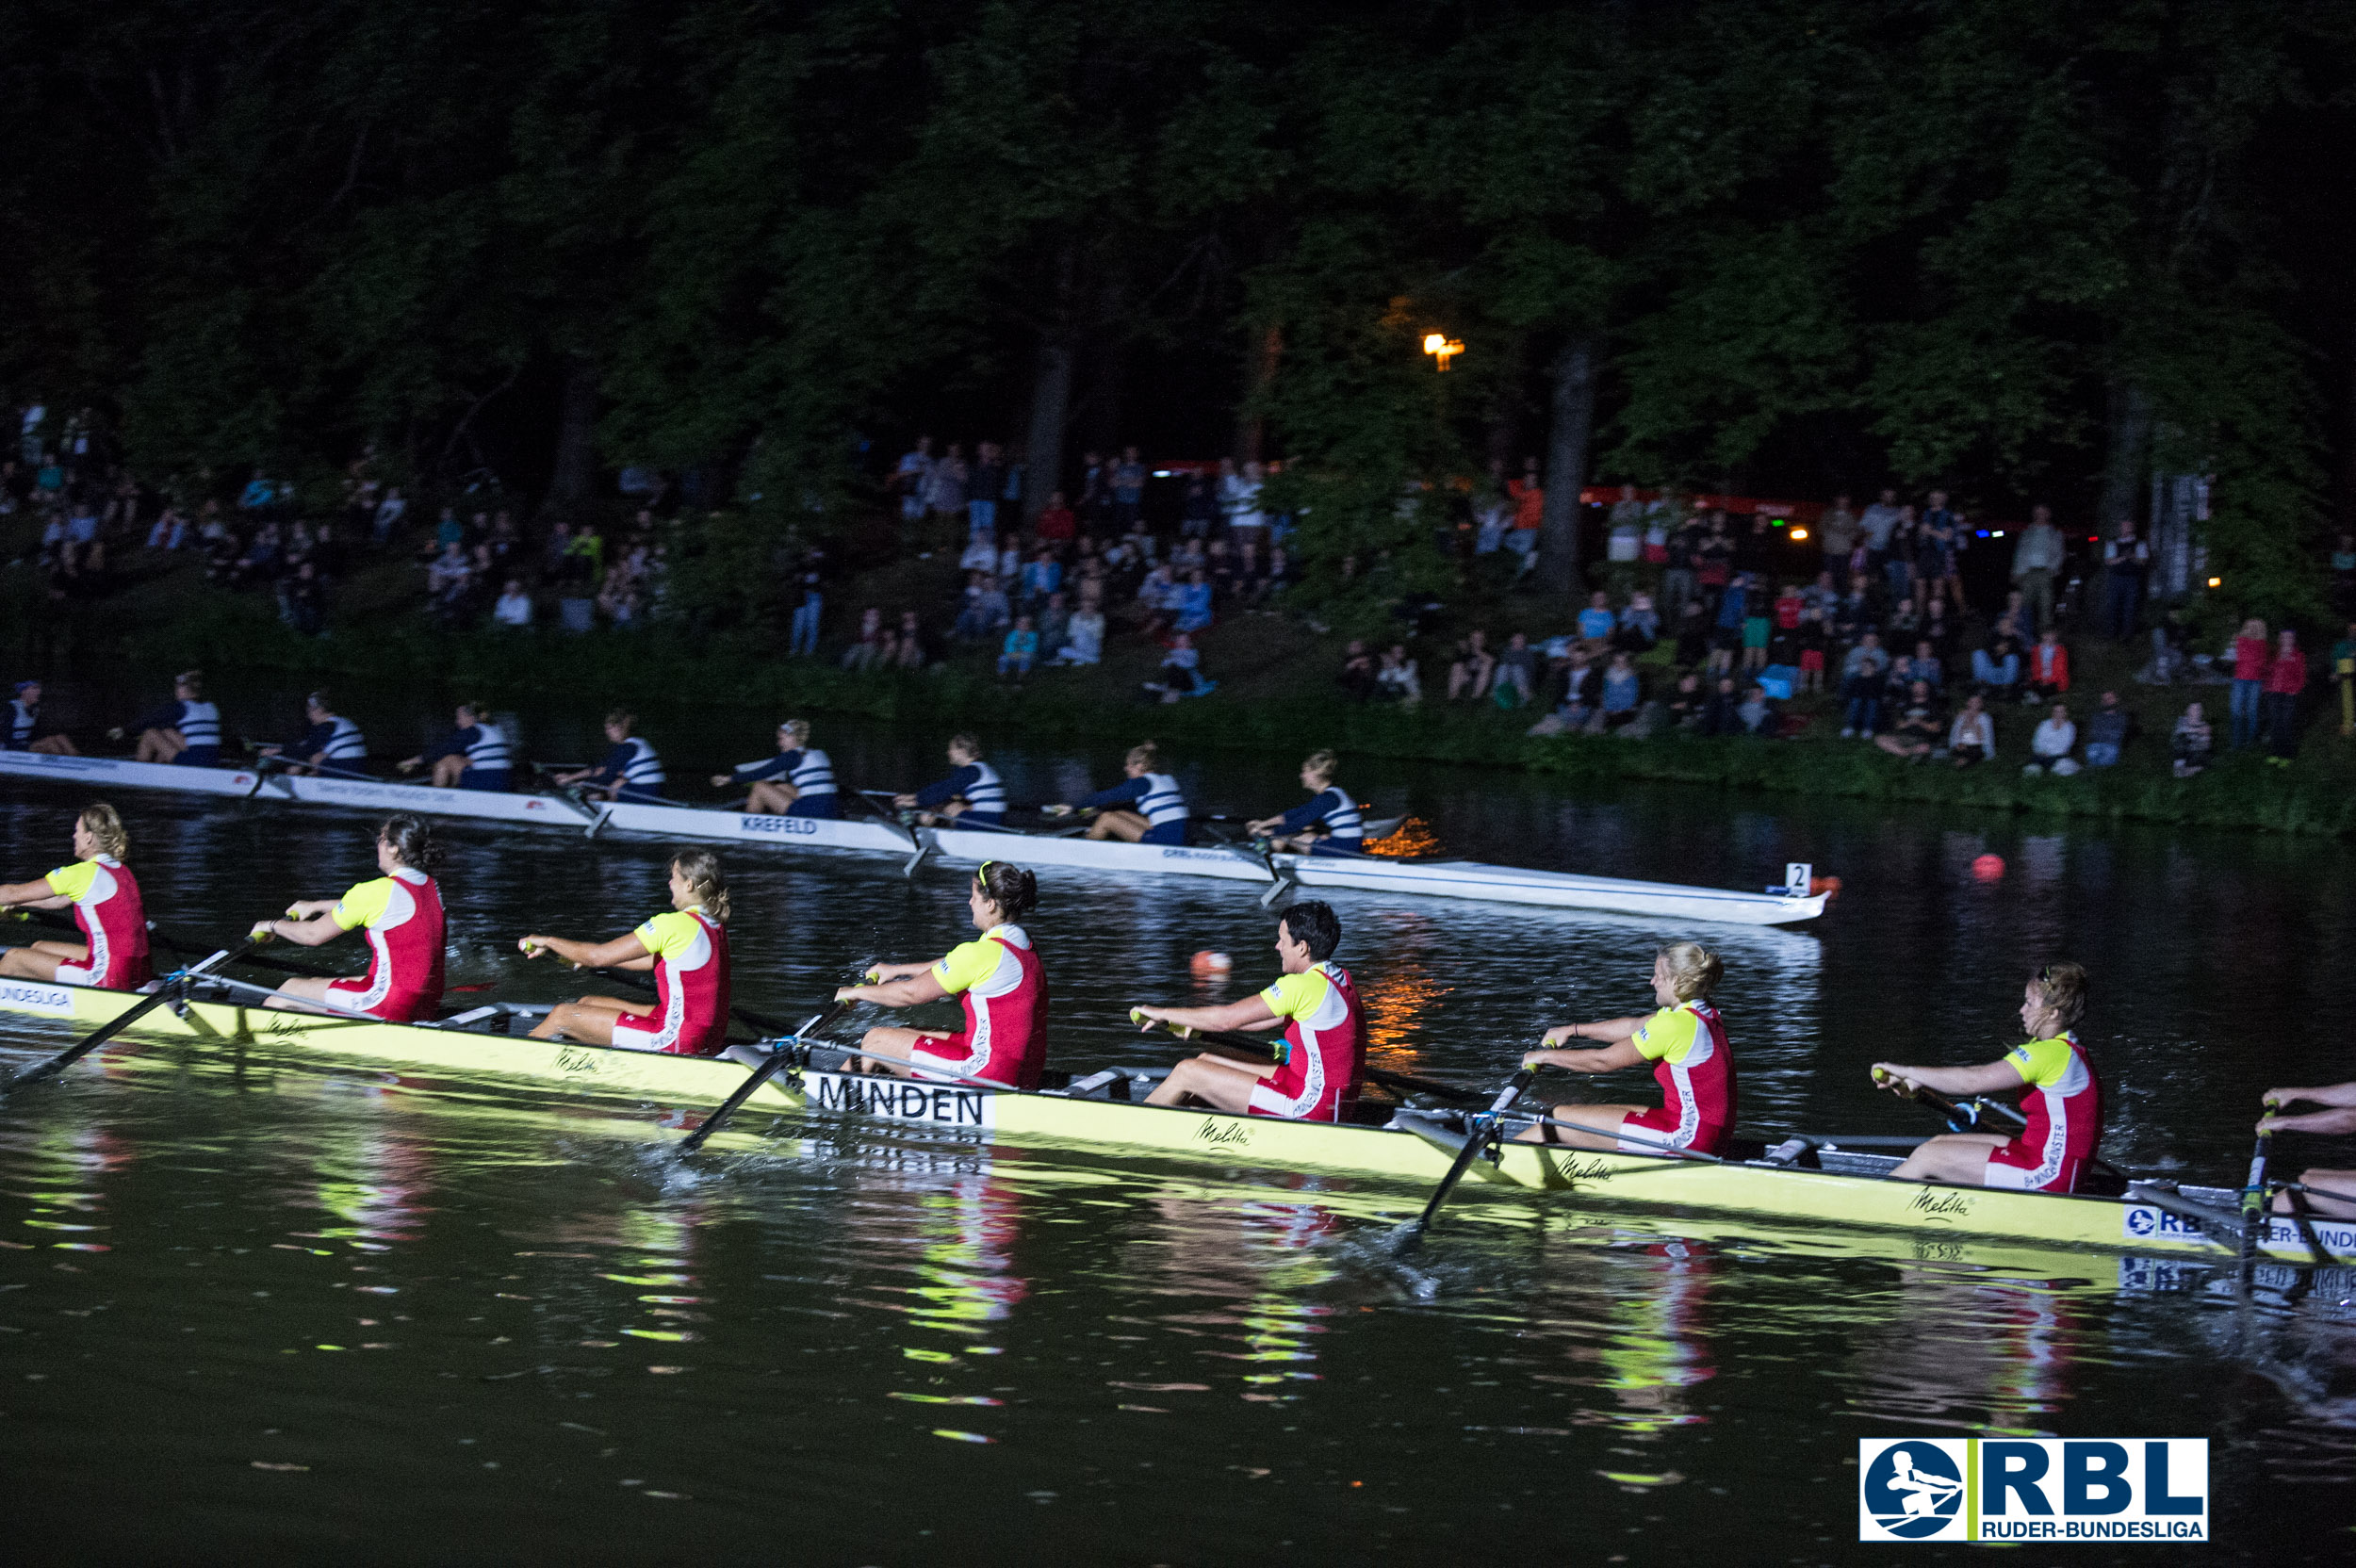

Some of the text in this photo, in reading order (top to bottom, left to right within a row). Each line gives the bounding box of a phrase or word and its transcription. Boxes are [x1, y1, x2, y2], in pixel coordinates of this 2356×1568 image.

[741, 816, 818, 835] KREFELD
[1793, 865, 1805, 887] 2
[817, 1075, 983, 1125] MINDEN
[1191, 1114, 1251, 1147] Melitta
[1551, 1150, 1614, 1183] Melitta
[1906, 1184, 1971, 1217] Melitta
